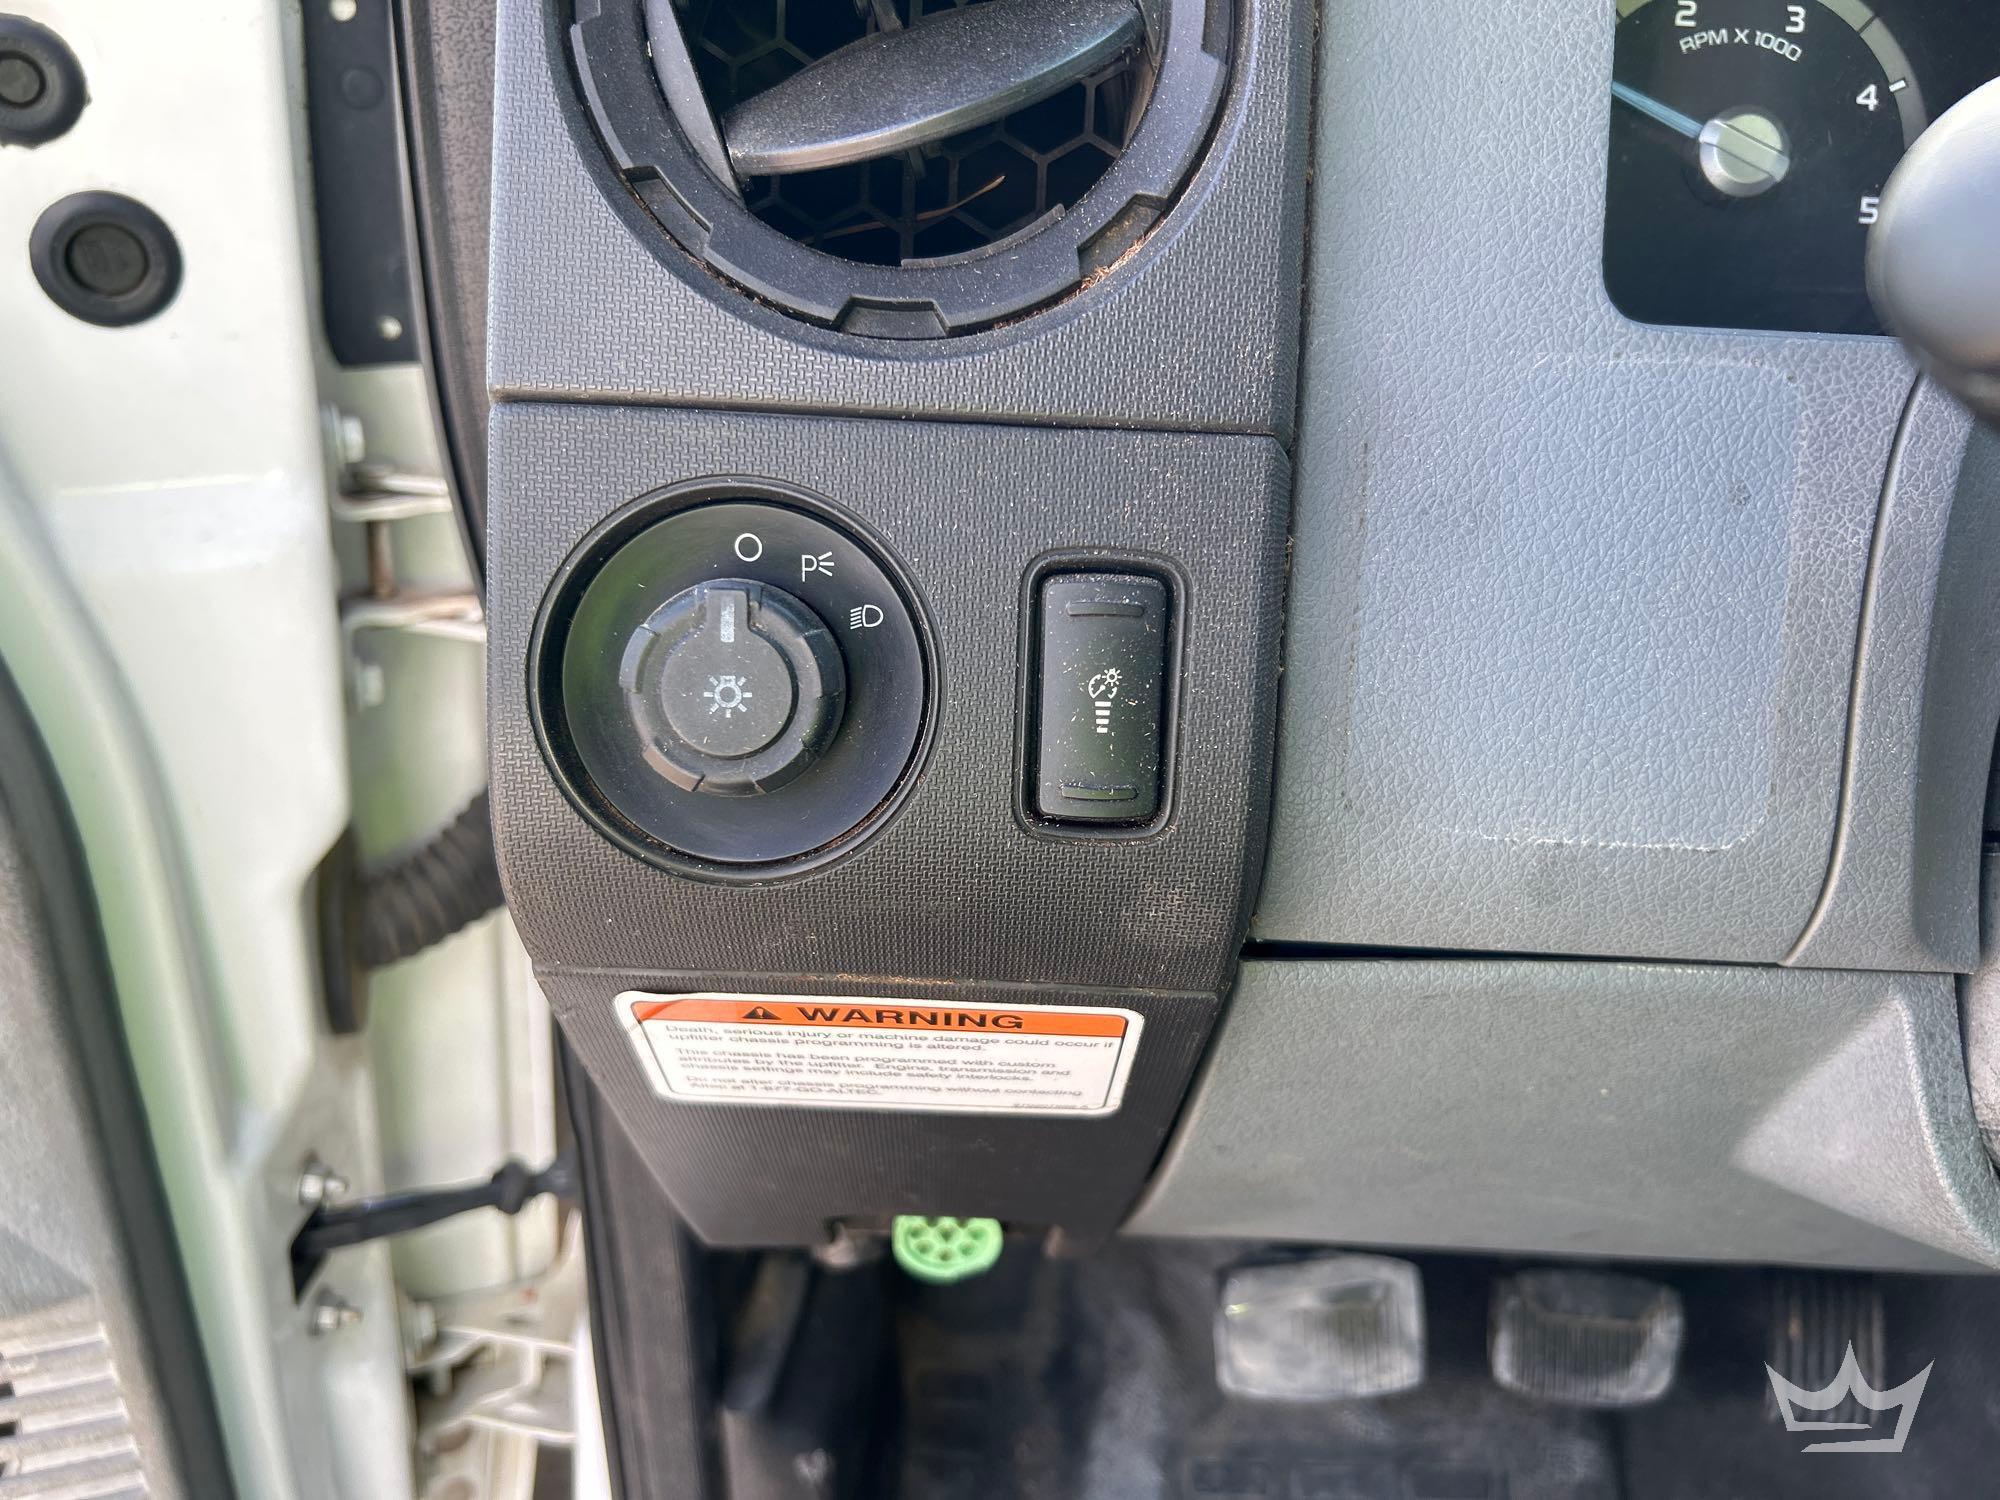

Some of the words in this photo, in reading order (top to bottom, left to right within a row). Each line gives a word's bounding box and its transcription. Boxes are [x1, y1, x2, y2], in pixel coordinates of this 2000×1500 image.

[1674, 1, 1697, 27] 2
[1785, 5, 1807, 34] 3
[1679, 28, 1729, 54] RPM
[1733, 29, 1751, 44] X
[1754, 30, 1802, 62] 1000
[1855, 83, 1879, 112] 4
[1858, 196, 1880, 225] 5
[797, 1007, 1023, 1029] WARNING
[666, 1025, 719, 1035] Death,
[788, 1030, 830, 1039] injury
[859, 1033, 928, 1041] machine
[933, 1036, 1000, 1044] damage
[1104, 1040, 1113, 1048] if
[729, 1036, 790, 1044] chassis
[795, 1040, 904, 1049] programming
[675, 1047, 708, 1055] This
[712, 1050, 772, 1058] chassis
[854, 1056, 957, 1064] programmed
